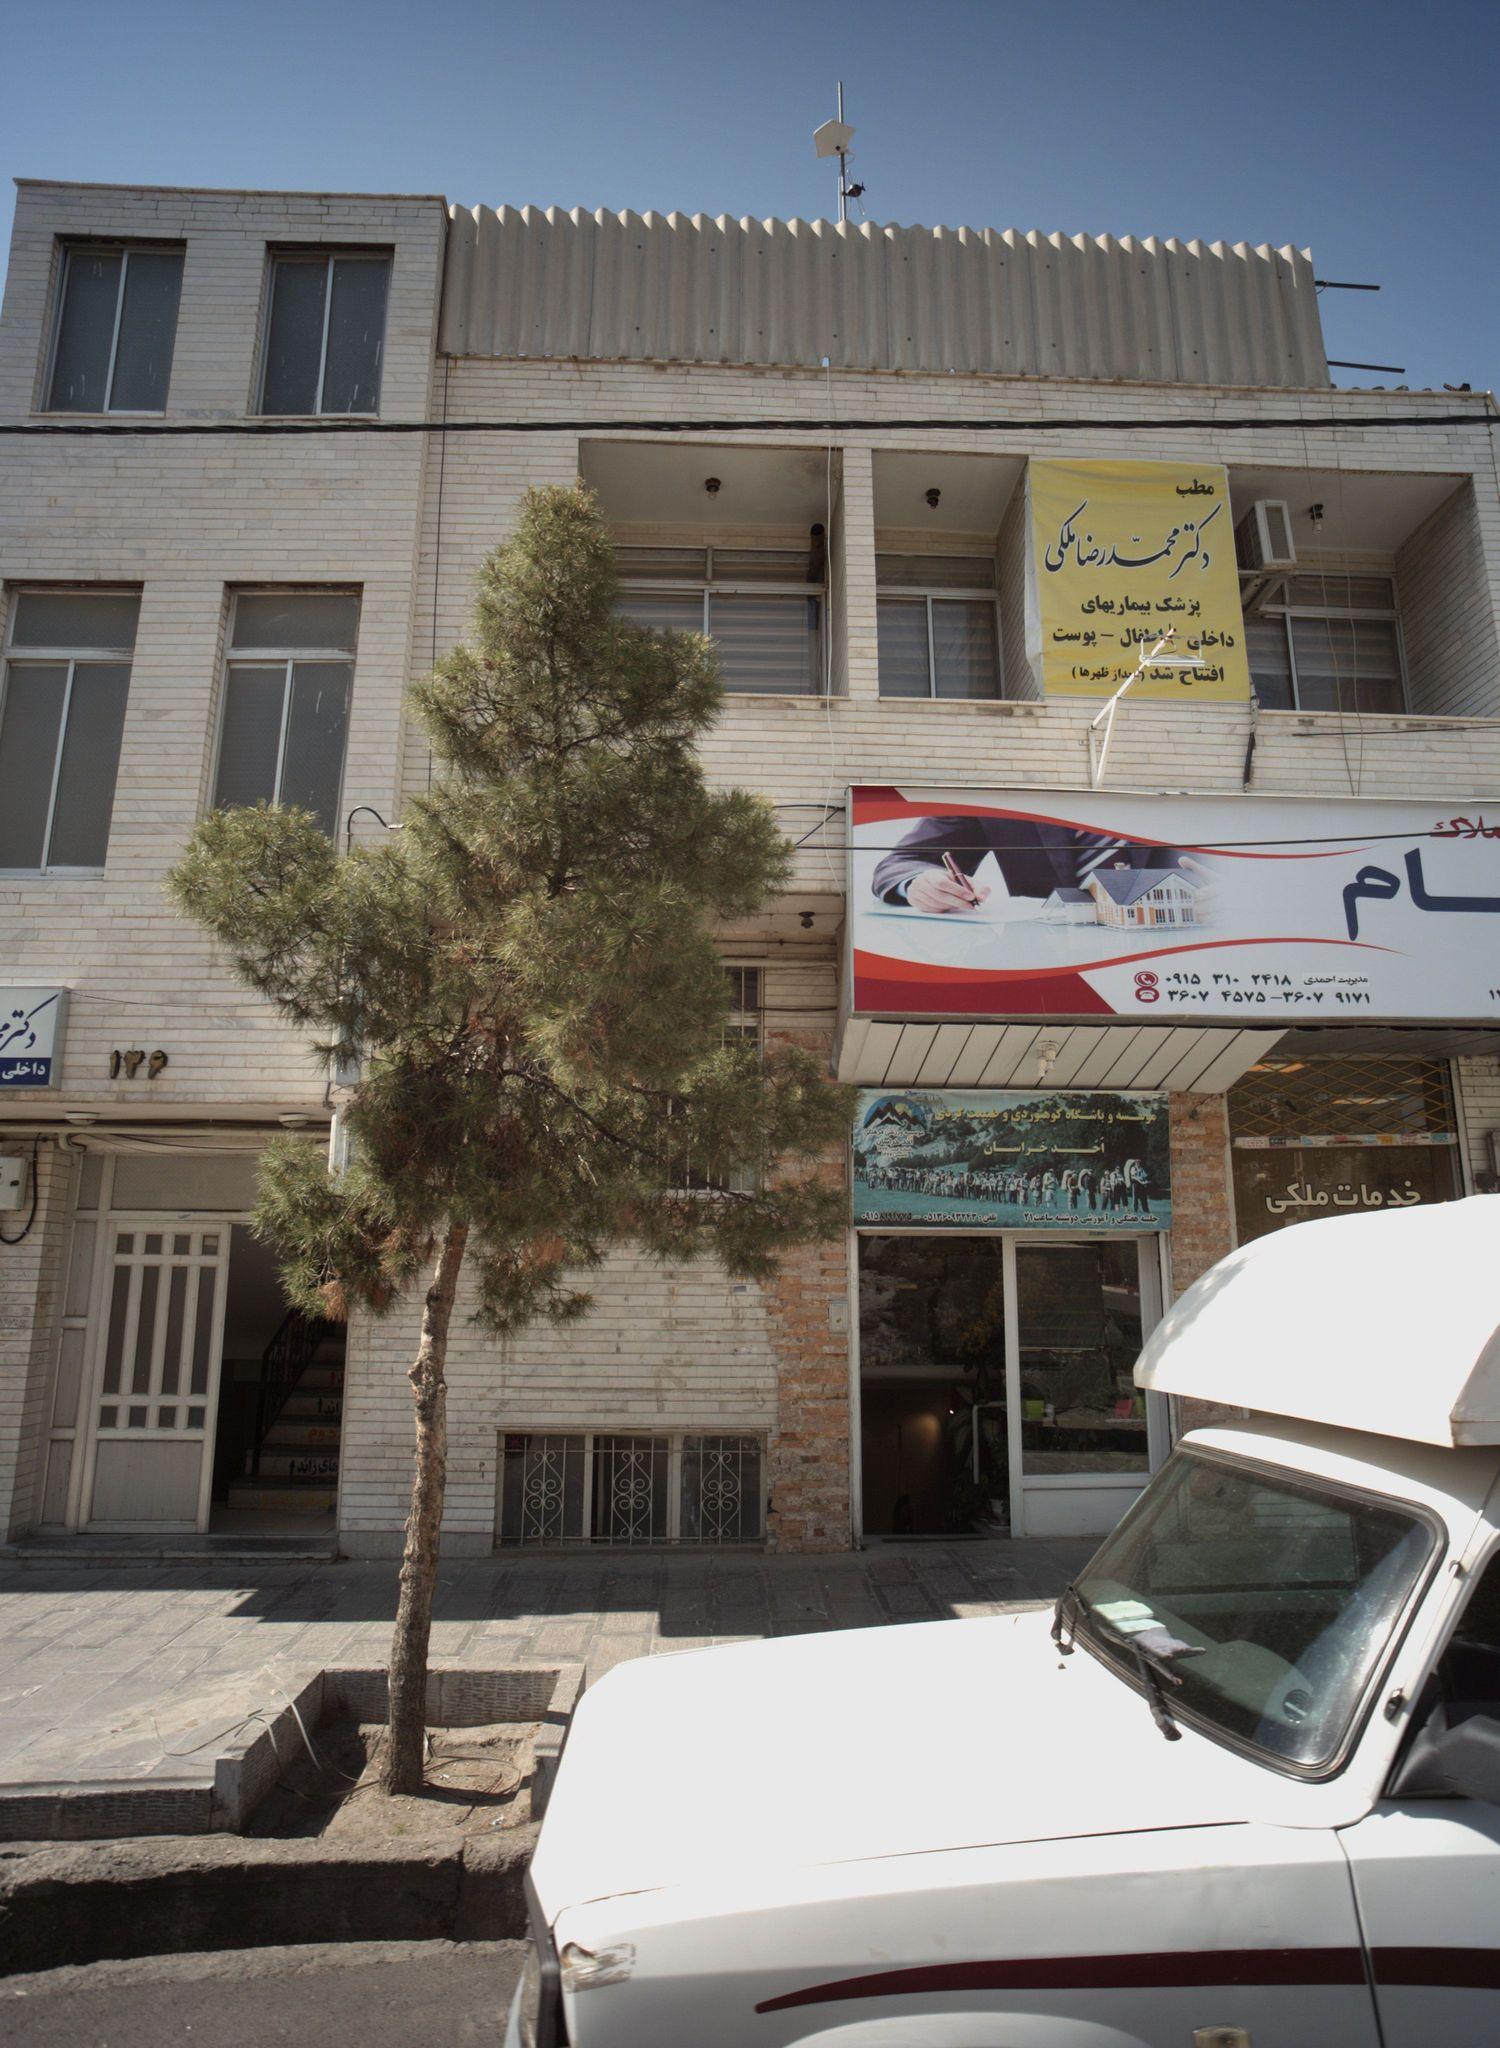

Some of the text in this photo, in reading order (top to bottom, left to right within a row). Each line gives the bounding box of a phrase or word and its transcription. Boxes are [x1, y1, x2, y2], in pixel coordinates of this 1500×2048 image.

[1176, 479, 1214, 498] مطب
[1045, 500, 1088, 573] ملکی
[1169, 503, 1222, 579] دکتر
[1155, 597, 1201, 617] پزشک
[1052, 628, 1097, 647] پوست
[1186, 629, 1235, 650] داخلی
[1149, 667, 1174, 680] شد
[1178, 665, 1225, 685] افتتاح
[1165, 972, 1292, 986] ۰۹۱۵ ۳۱۰ ۲۴۱۸
[1167, 990, 1209, 1002] ۳۶۰۷
[1335, 990, 1370, 1004] ۹۱۷۱
[1, 1061, 46, 1079] داخلی
[1002, 1111, 1008, 1122] و
[1107, 1112, 1114, 1124] و
[983, 1141, 1048, 1156] خراسان
[1265, 1180, 1421, 1214] خدمات ملکی
